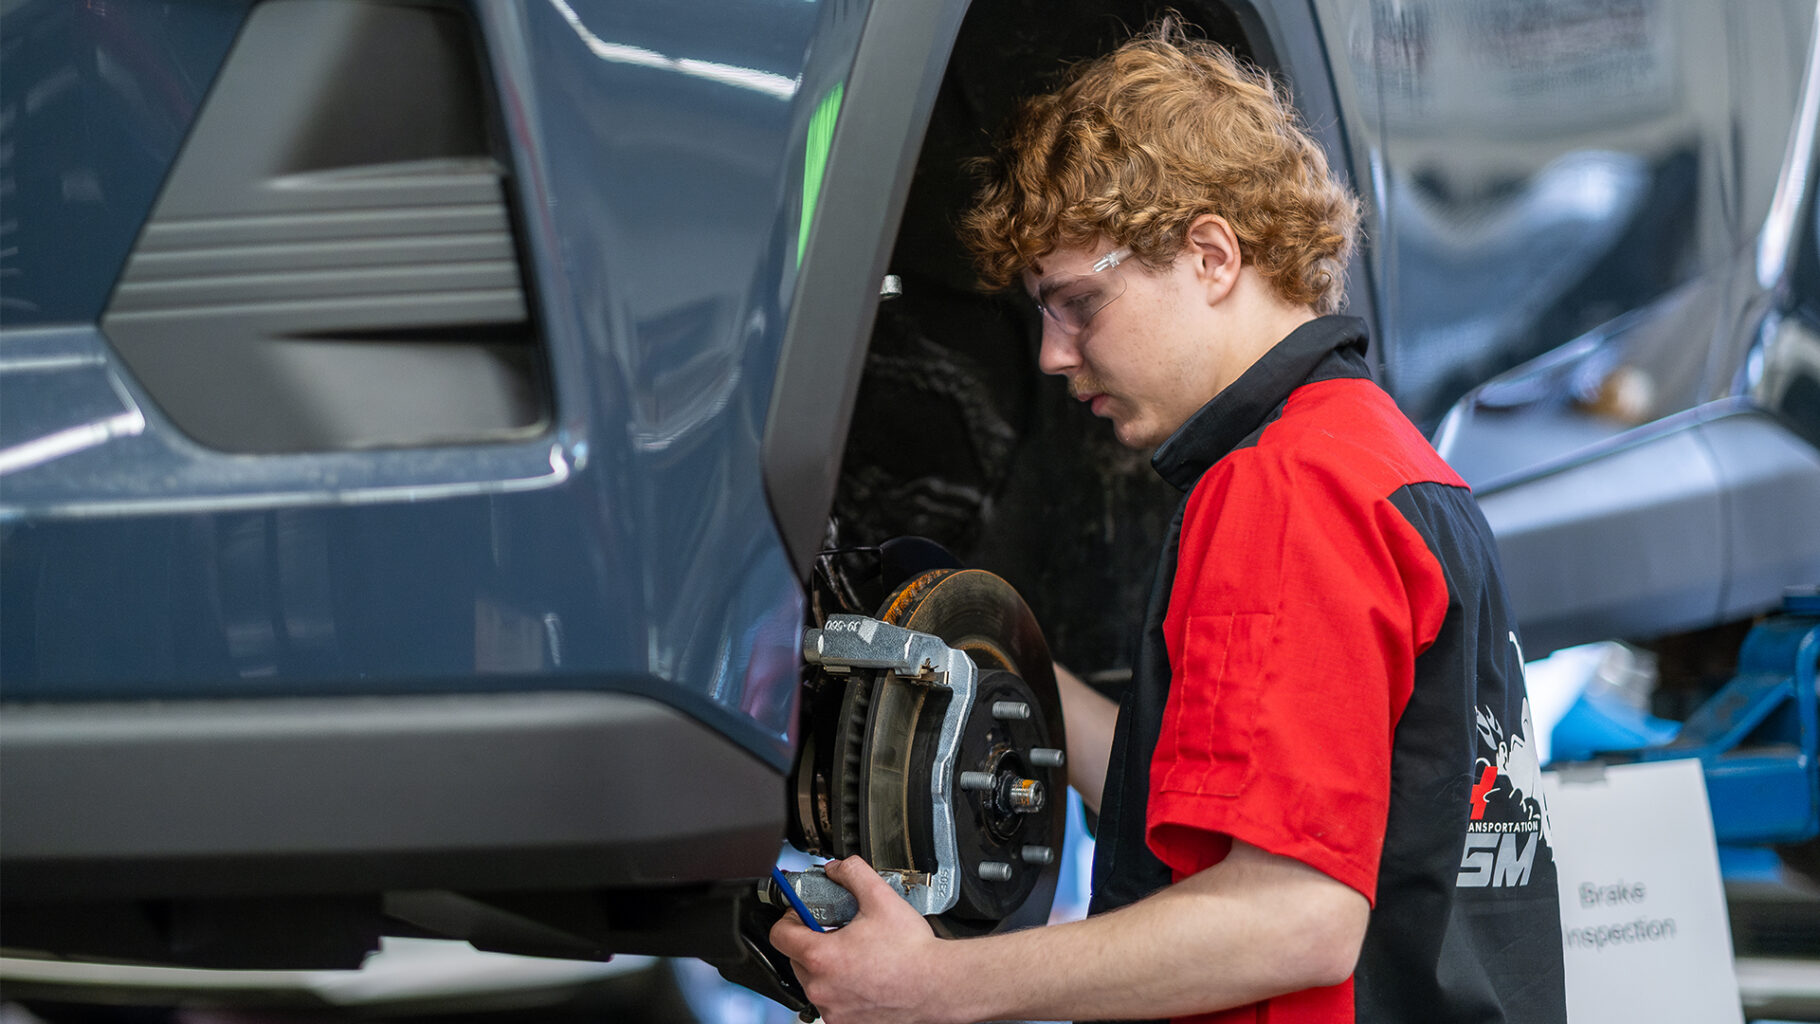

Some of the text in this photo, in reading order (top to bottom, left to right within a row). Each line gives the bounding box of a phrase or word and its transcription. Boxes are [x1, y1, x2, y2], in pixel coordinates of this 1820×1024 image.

[1468, 821, 1539, 833] ANSPORTATION
[1578, 879, 1647, 909] Brake
[1565, 916, 1677, 953] nspection
